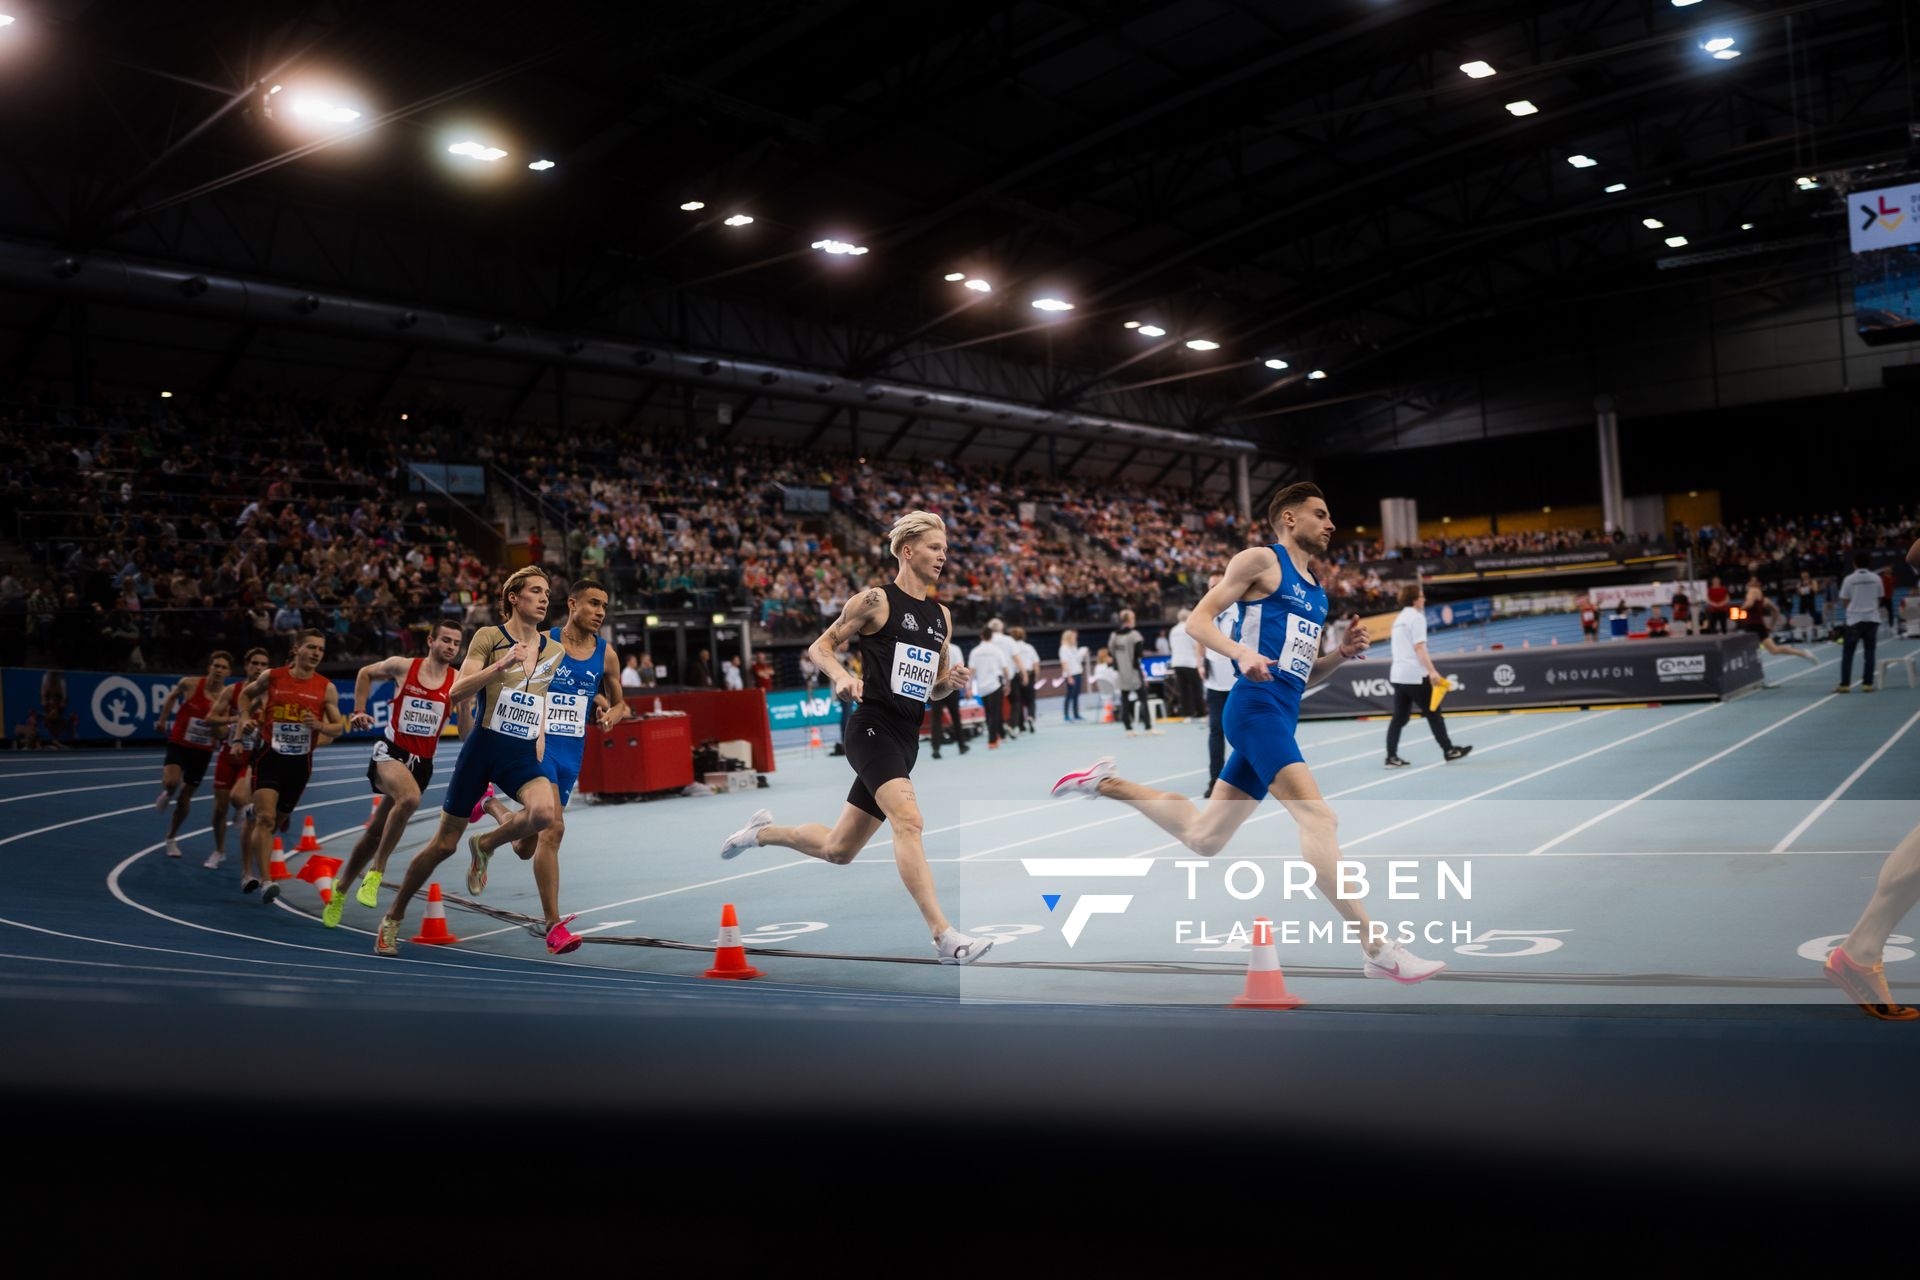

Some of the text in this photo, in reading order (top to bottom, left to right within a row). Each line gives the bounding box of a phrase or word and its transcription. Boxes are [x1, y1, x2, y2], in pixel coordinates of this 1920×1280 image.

[1298, 621, 1319, 639] GLS
[906, 647, 932, 663] GLS
[1677, 658, 1704, 667] PLAN
[898, 662, 935, 686] FARKEN
[1558, 666, 1634, 681] NOVAFON
[411, 700, 433, 710] GLS
[511, 692, 535, 706] GLS
[552, 695, 576, 706] GLS
[496, 703, 540, 726] M.TORTELL
[547, 708, 579, 722] ZITTEL
[800, 697, 831, 718] WGV
[404, 710, 439, 725] SIETMANN
[280, 724, 301, 732] GLS
[512, 725, 528, 733] PLAN
[711, 921, 830, 944] 2
[1453, 929, 1576, 957] 5
[1797, 933, 1917, 962] 6
